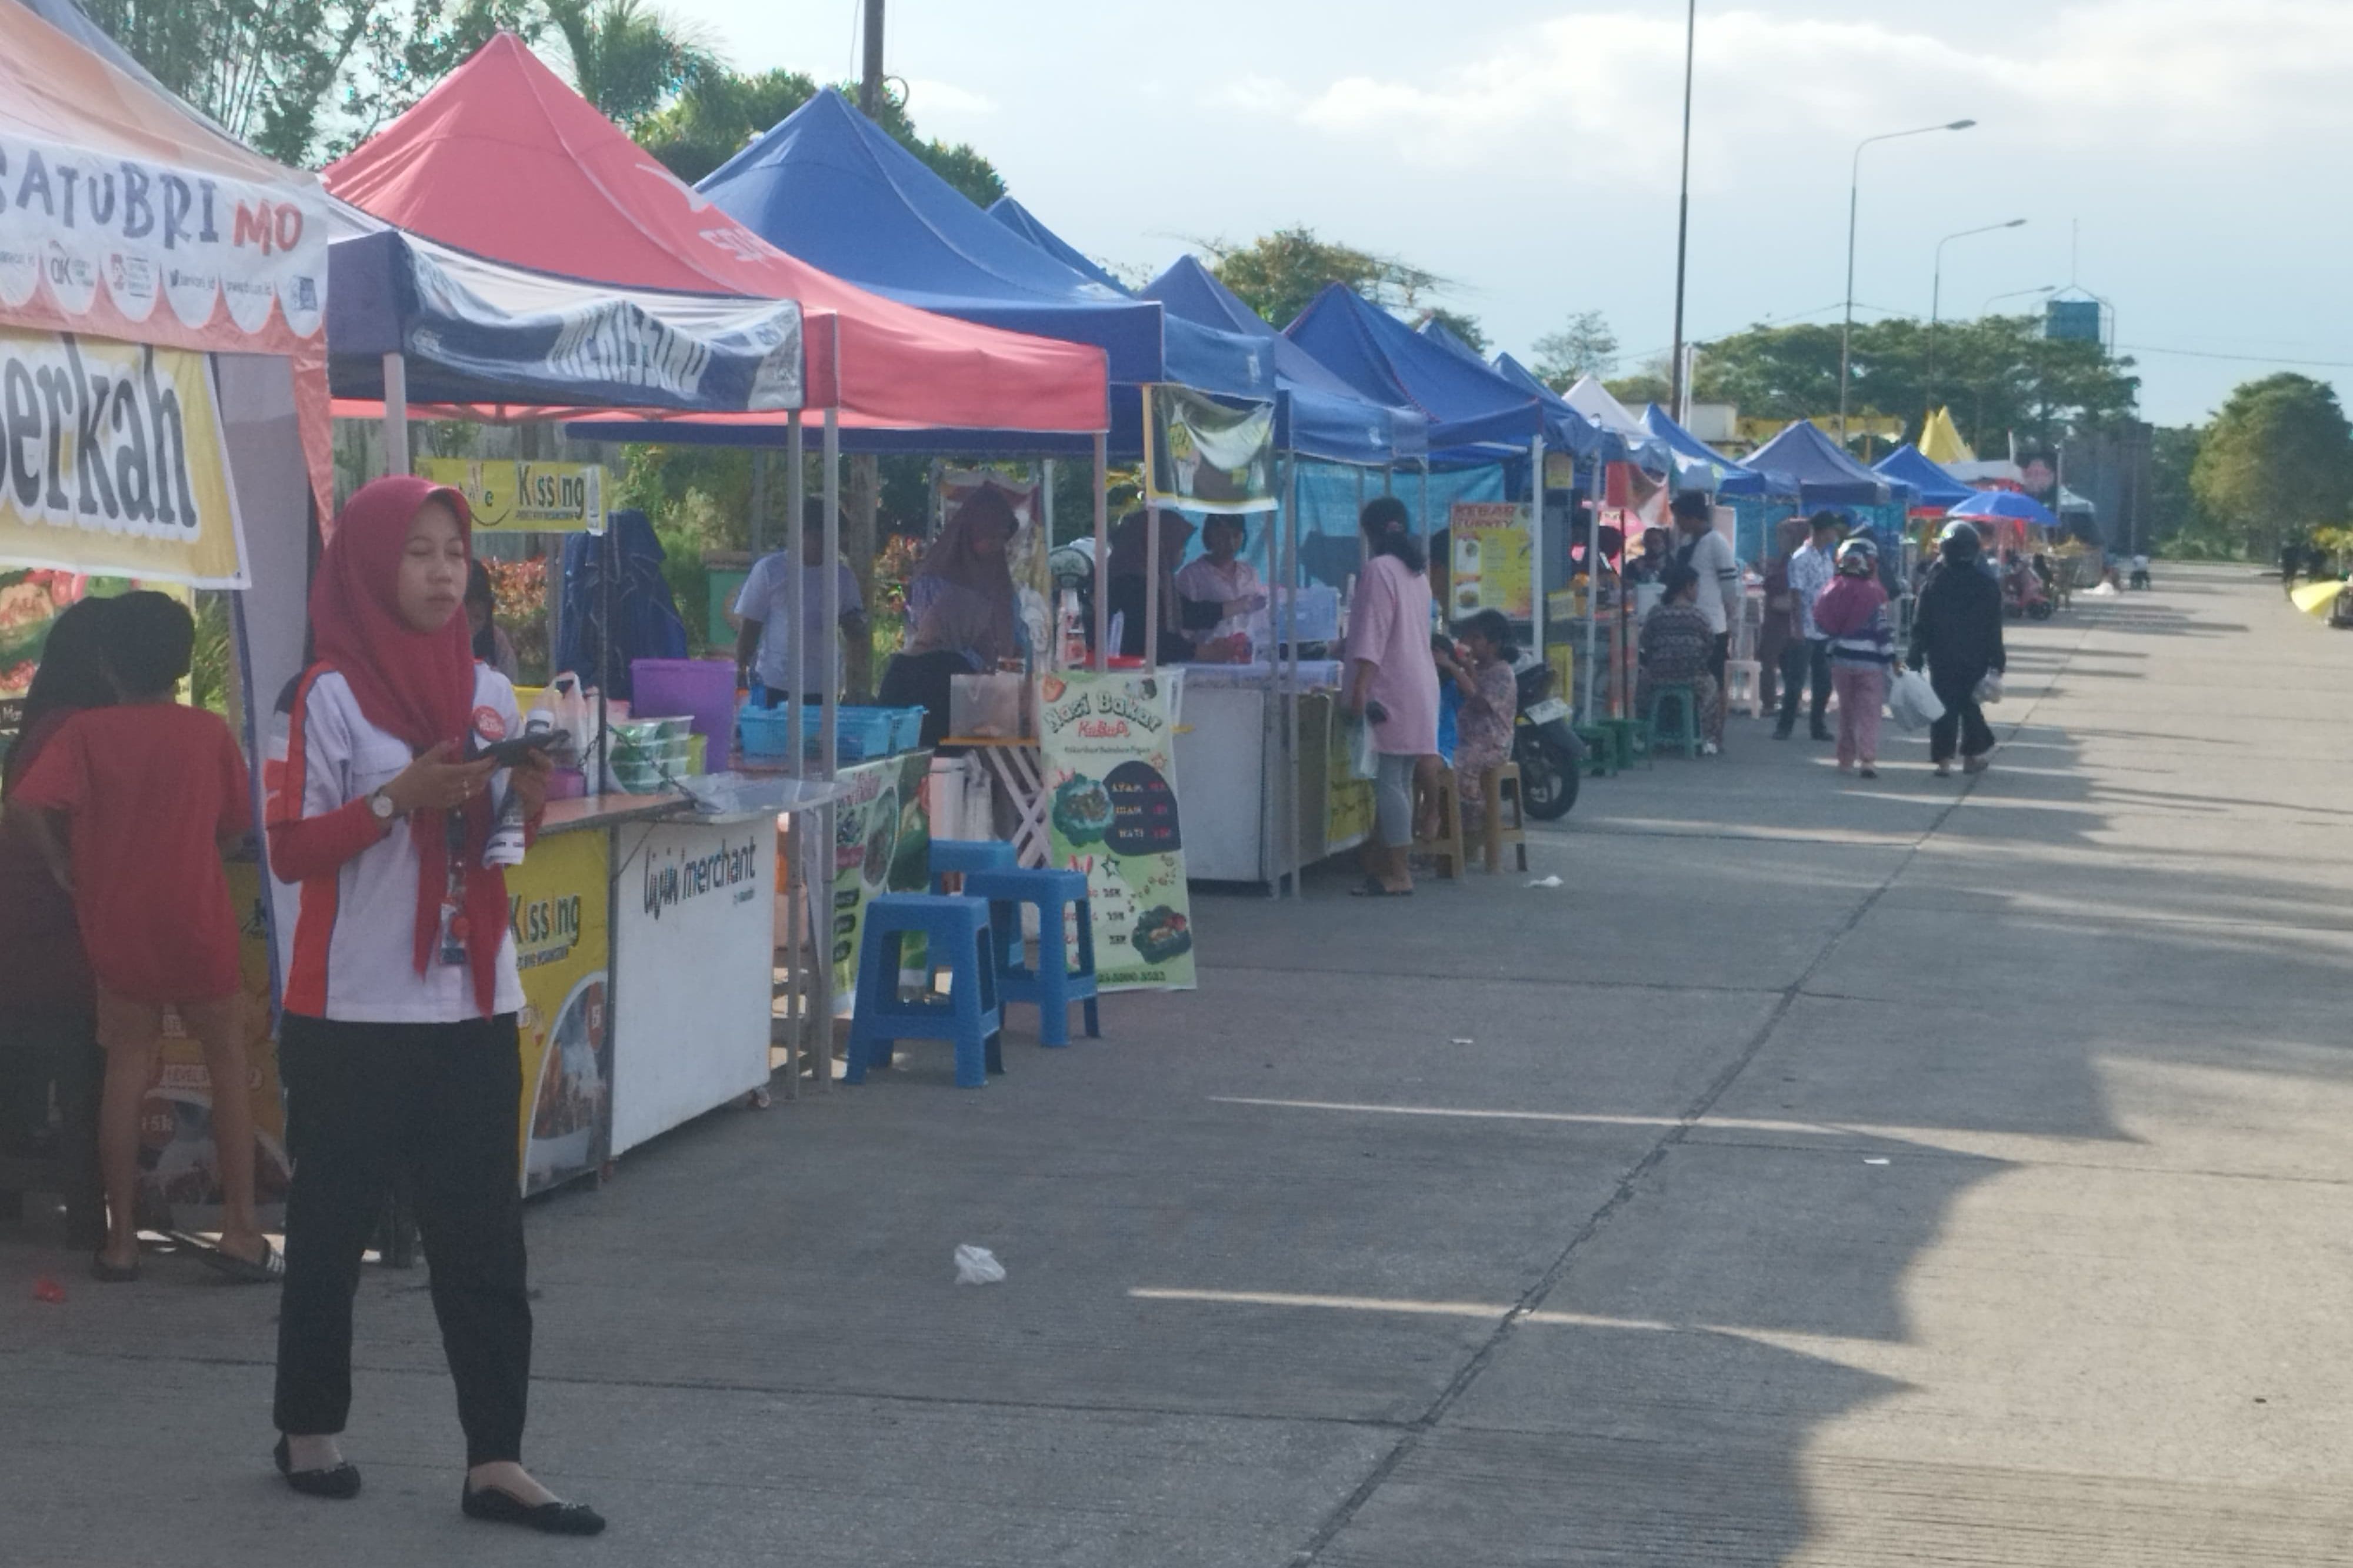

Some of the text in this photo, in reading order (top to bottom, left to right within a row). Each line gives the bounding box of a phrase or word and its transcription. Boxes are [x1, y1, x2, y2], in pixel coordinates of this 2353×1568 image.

[0, 331, 197, 528] erkah
[518, 464, 585, 521] Kissing
[682, 835, 756, 900] merchant
[509, 895, 581, 948] Kissing
